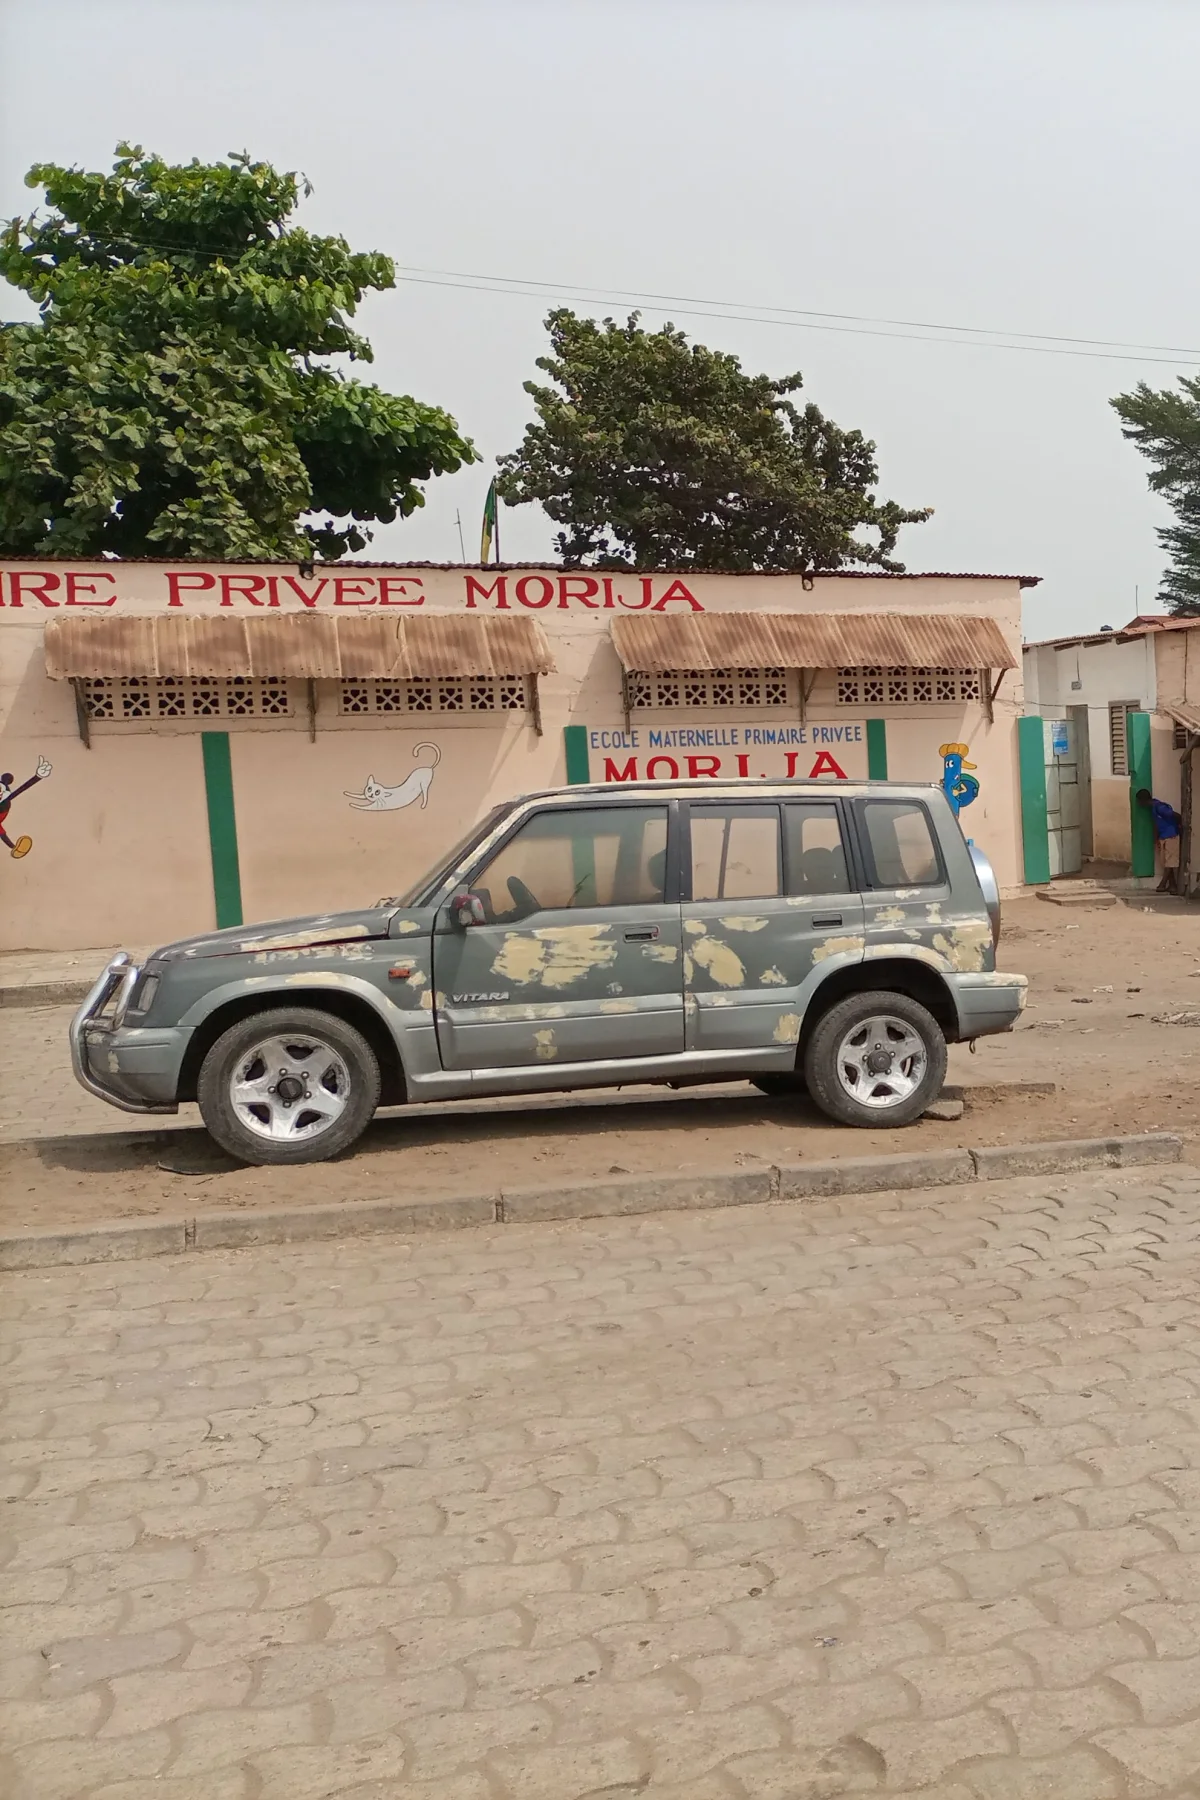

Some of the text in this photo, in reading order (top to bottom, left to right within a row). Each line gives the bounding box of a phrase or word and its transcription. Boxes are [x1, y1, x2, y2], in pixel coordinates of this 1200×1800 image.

[164, 572, 425, 607] PRIVEE
[464, 575, 705, 611] MORIJA
[590, 726, 863, 749] ECOLE MATERNELLE PRIMAIRE PRIVEE
[452, 991, 510, 1003] VITARA
